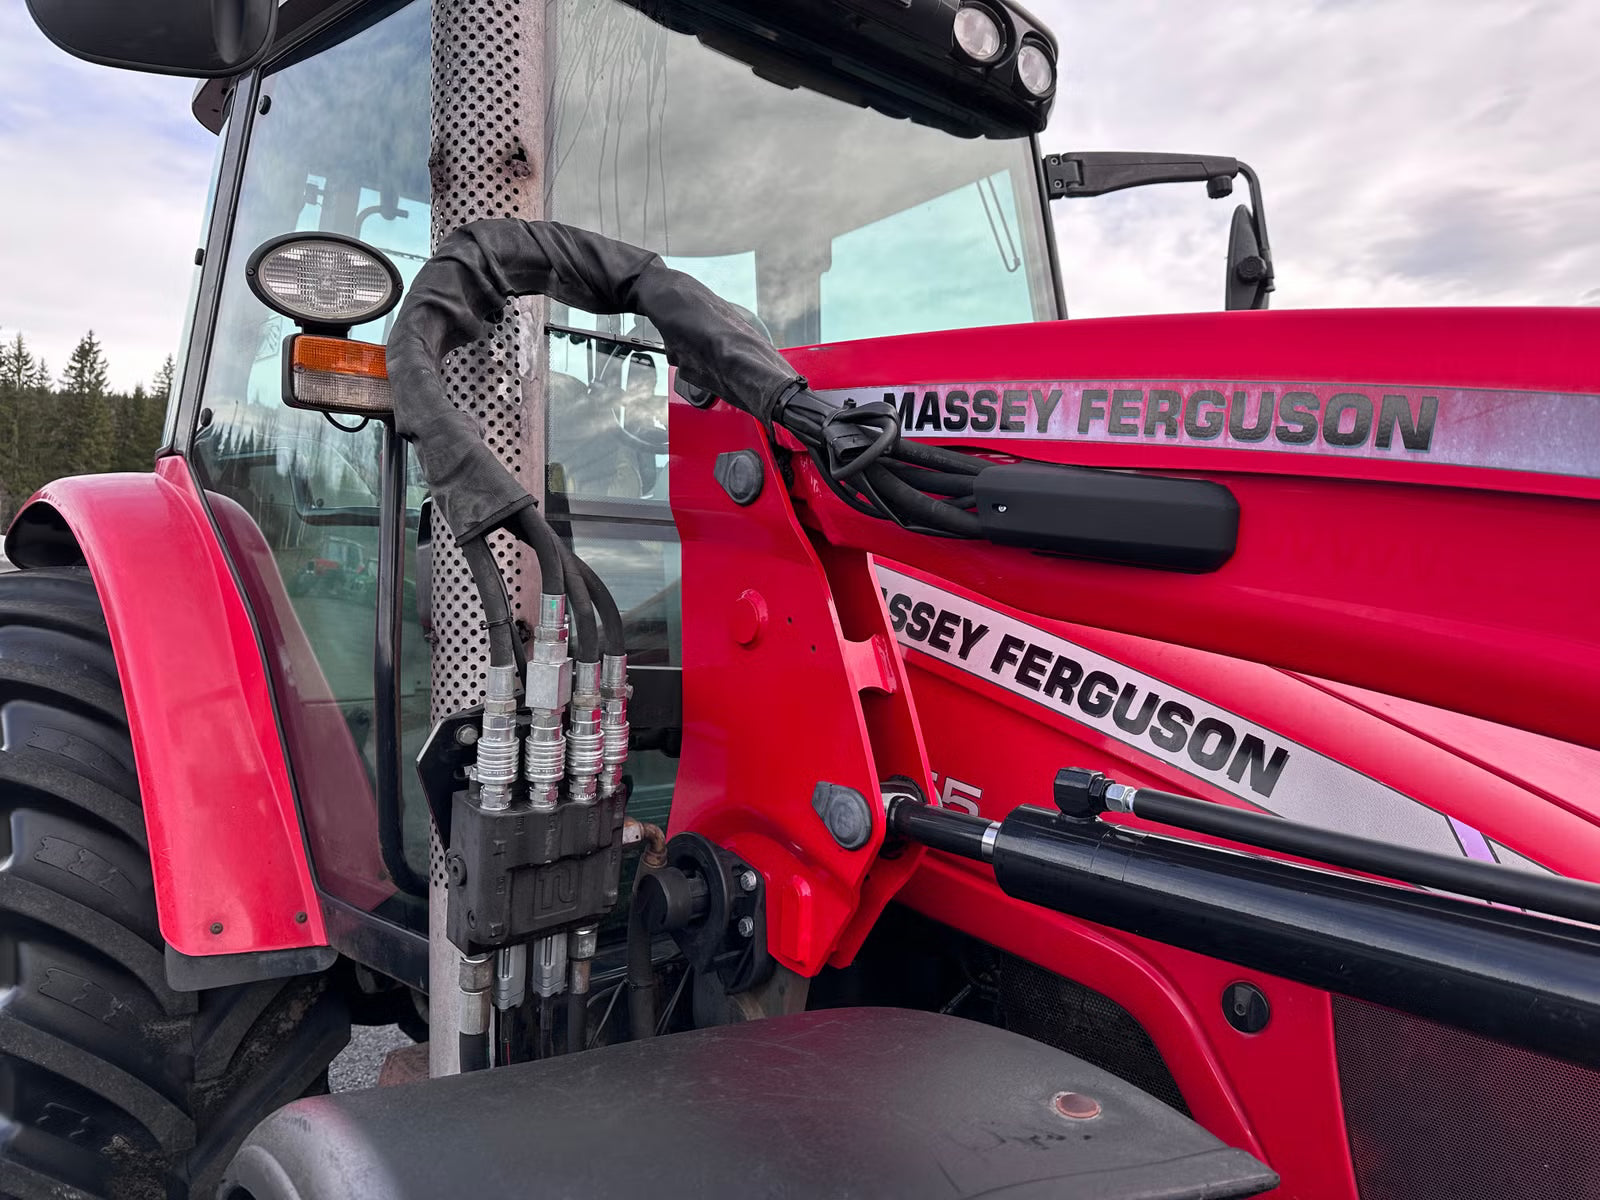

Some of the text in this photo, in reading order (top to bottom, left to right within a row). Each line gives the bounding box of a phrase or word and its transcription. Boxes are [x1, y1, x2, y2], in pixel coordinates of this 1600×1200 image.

[884, 389, 1439, 453] MASSEY FERGUSON
[881, 587, 1290, 798] SSEY FERGUSON
[931, 770, 983, 817] 5
